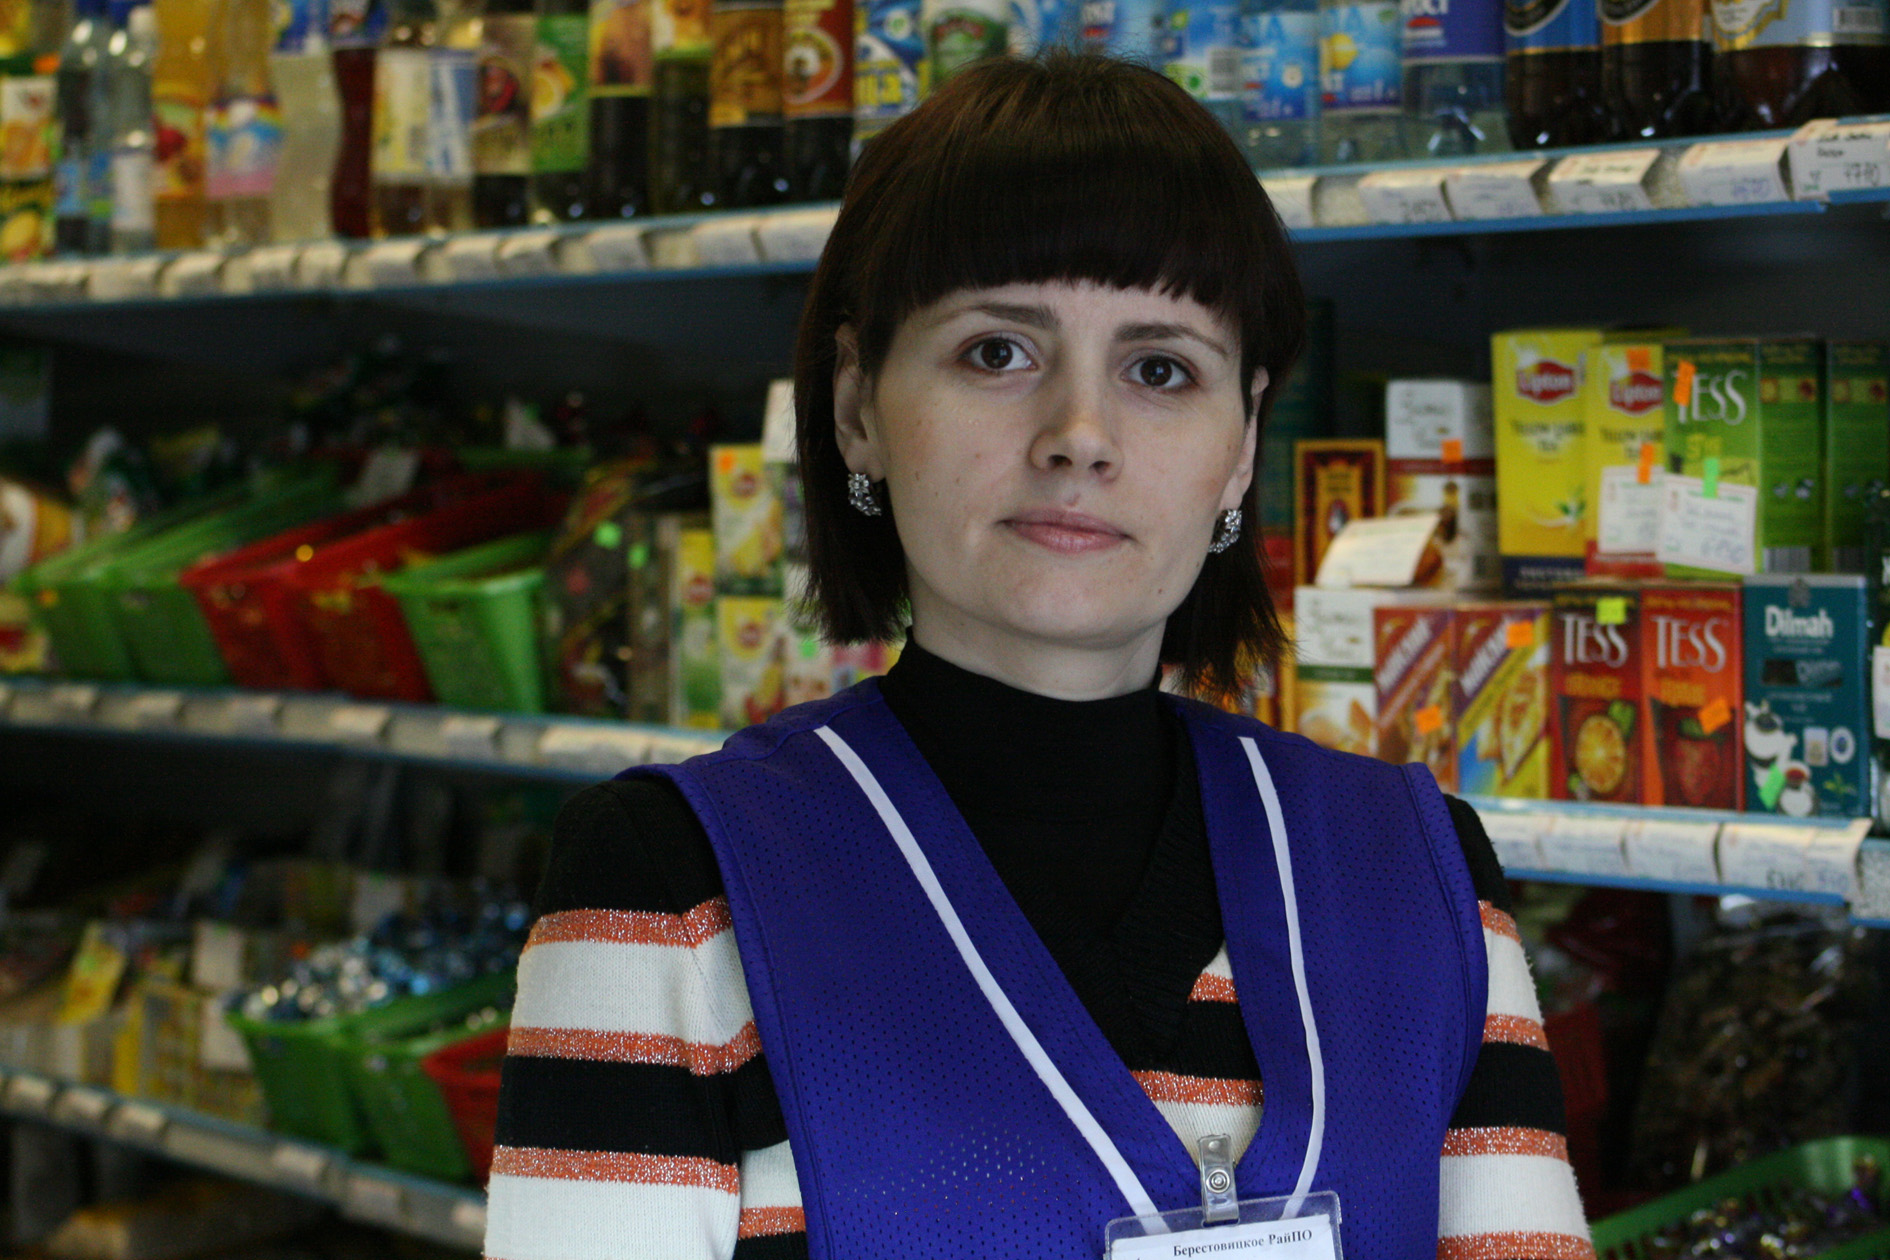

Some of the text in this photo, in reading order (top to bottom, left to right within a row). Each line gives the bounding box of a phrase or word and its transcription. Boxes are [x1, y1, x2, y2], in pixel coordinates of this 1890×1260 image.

[1517, 372, 1573, 396] Lipton
[1764, 604, 1834, 639] Dilmah
[1558, 612, 1629, 668] TESS
[1650, 615, 1728, 673] TESS
[1173, 1229, 1313, 1258] Берестовицкое РайПО
